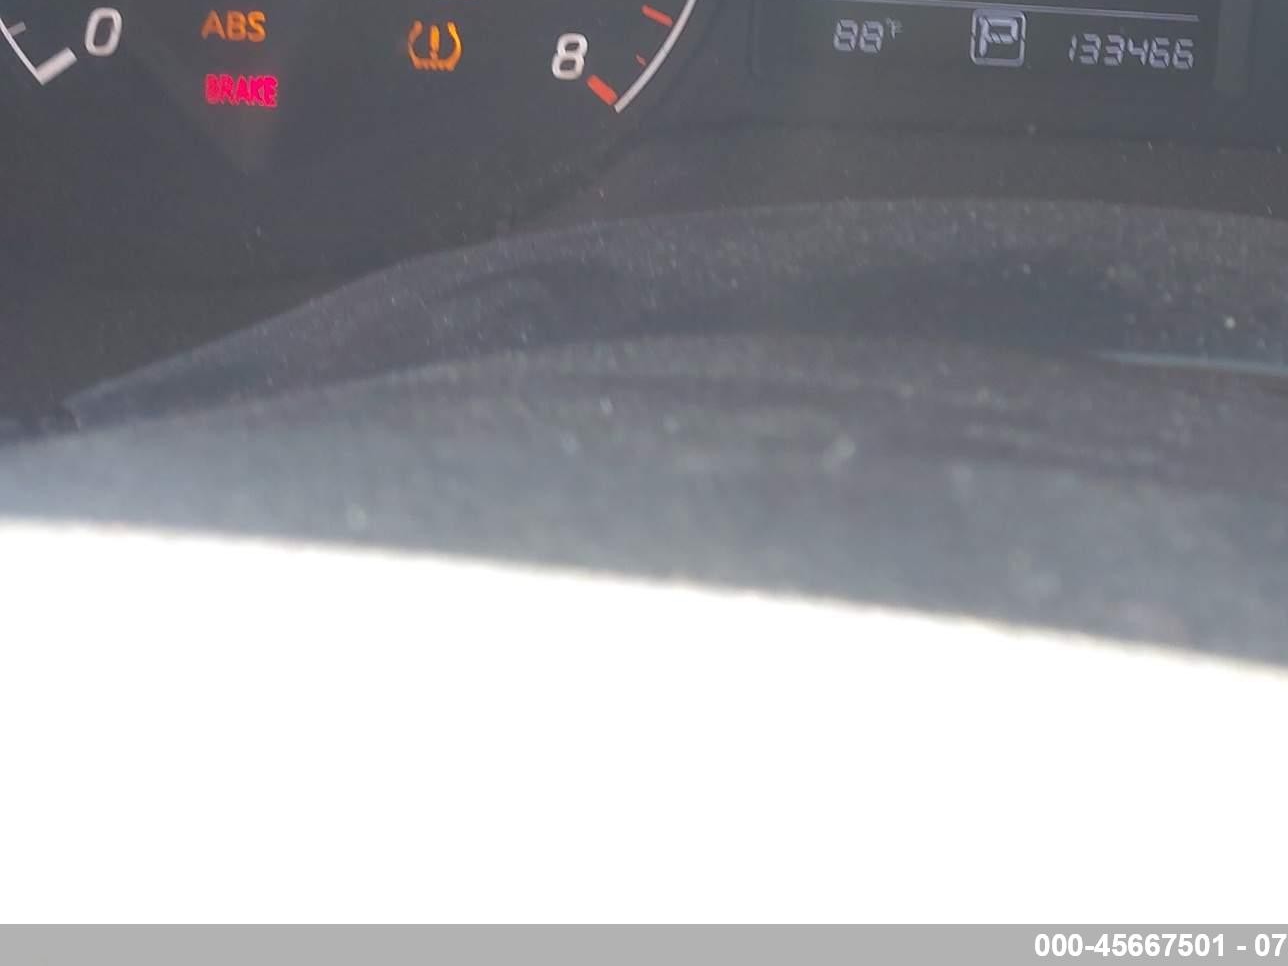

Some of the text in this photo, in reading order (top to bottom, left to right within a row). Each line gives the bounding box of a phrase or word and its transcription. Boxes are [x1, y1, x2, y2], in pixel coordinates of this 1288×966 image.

[85, 8, 121, 55] 0
[203, 11, 265, 42] ABS
[979, 16, 1020, 57] P
[552, 34, 587, 79] 8
[1069, 34, 1193, 68] 133466
[206, 74, 278, 107] BRAKE
